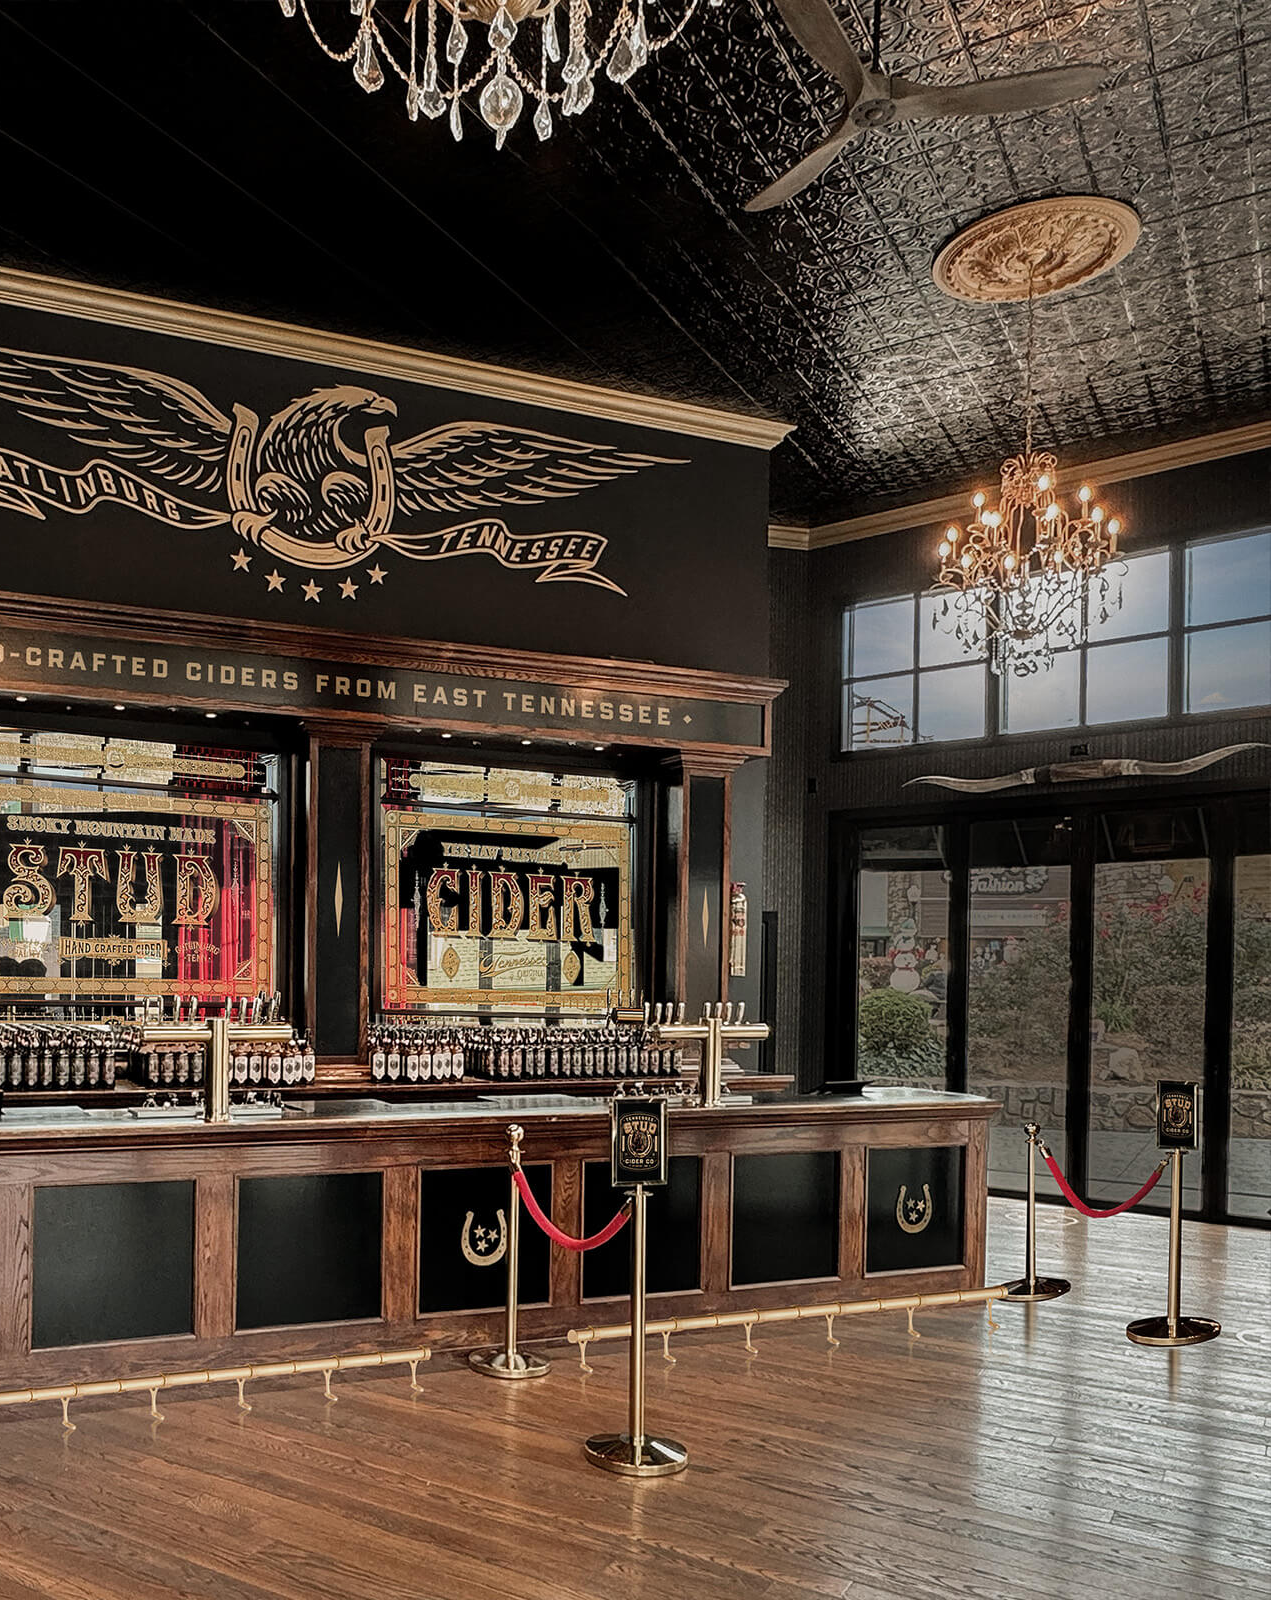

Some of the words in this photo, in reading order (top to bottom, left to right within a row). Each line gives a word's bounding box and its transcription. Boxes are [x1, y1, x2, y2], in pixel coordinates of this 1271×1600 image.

[440, 527, 597, 562] TENNESSEE
[185, 660, 300, 692] CIDERS
[314, 673, 398, 701] FROM
[413, 683, 488, 710] EAST
[502, 692, 671, 726] TENNESSEE
[6, 815, 72, 835] SMOKY
[74, 819, 166, 841] MOUNTAIN
[169, 825, 217, 844] MADE
[3, 840, 220, 925] STUD
[427, 866, 597, 942] CIDER
[64, 939, 91, 955] HAND
[94, 944, 134, 954] CRAFTED
[135, 942, 162, 958] CIDER
[1164, 1098, 1192, 1111] STUD
[623, 1121, 657, 1134] STUD
